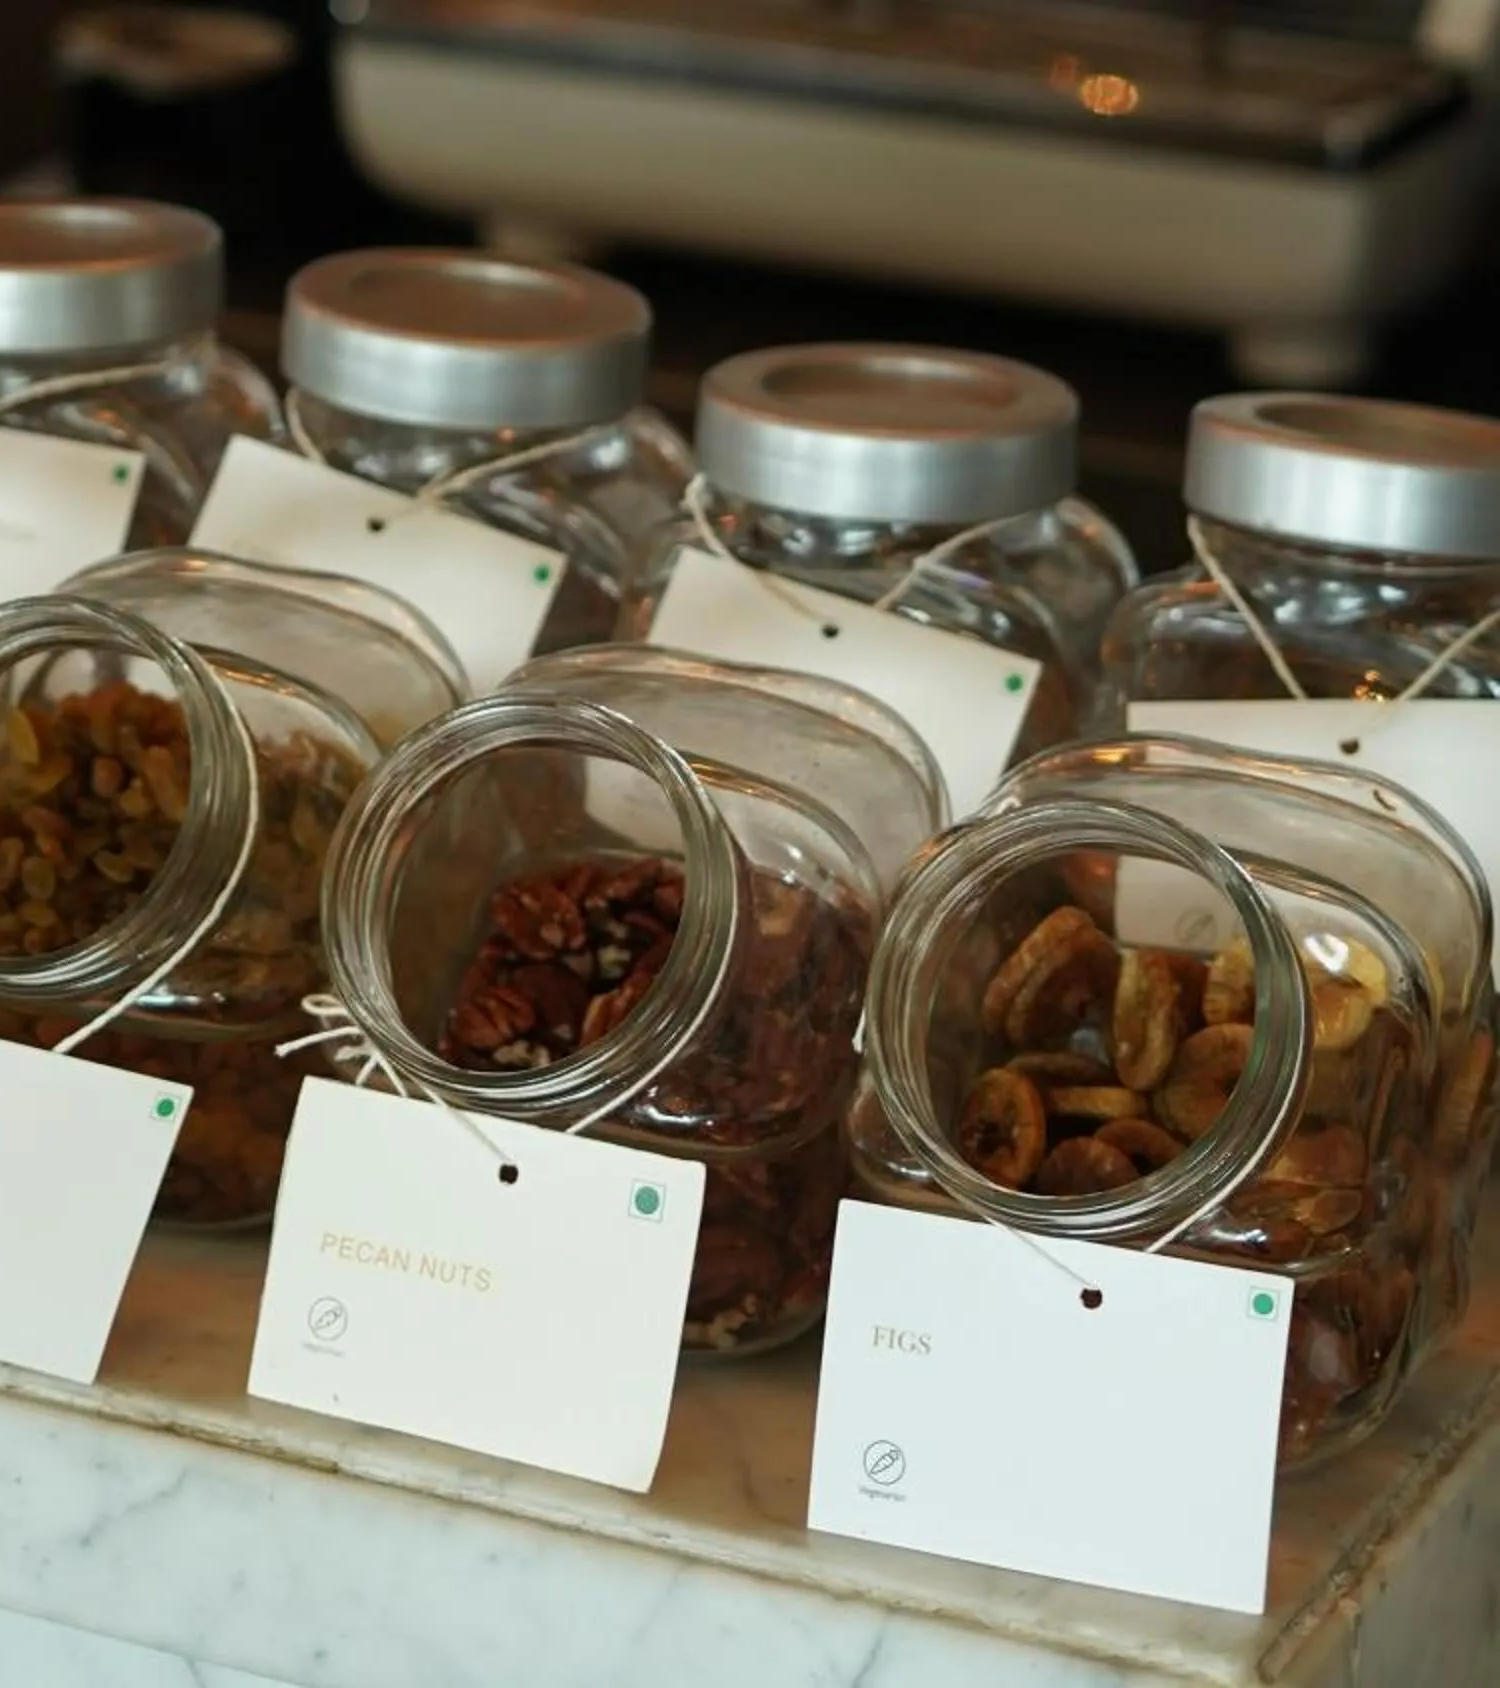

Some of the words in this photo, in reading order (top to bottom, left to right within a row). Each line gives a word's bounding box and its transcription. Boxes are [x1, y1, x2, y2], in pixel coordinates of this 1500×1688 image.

[319, 1231, 411, 1273] PECAN
[418, 1252, 493, 1292] NUTS
[871, 1325, 932, 1356] FIGS
